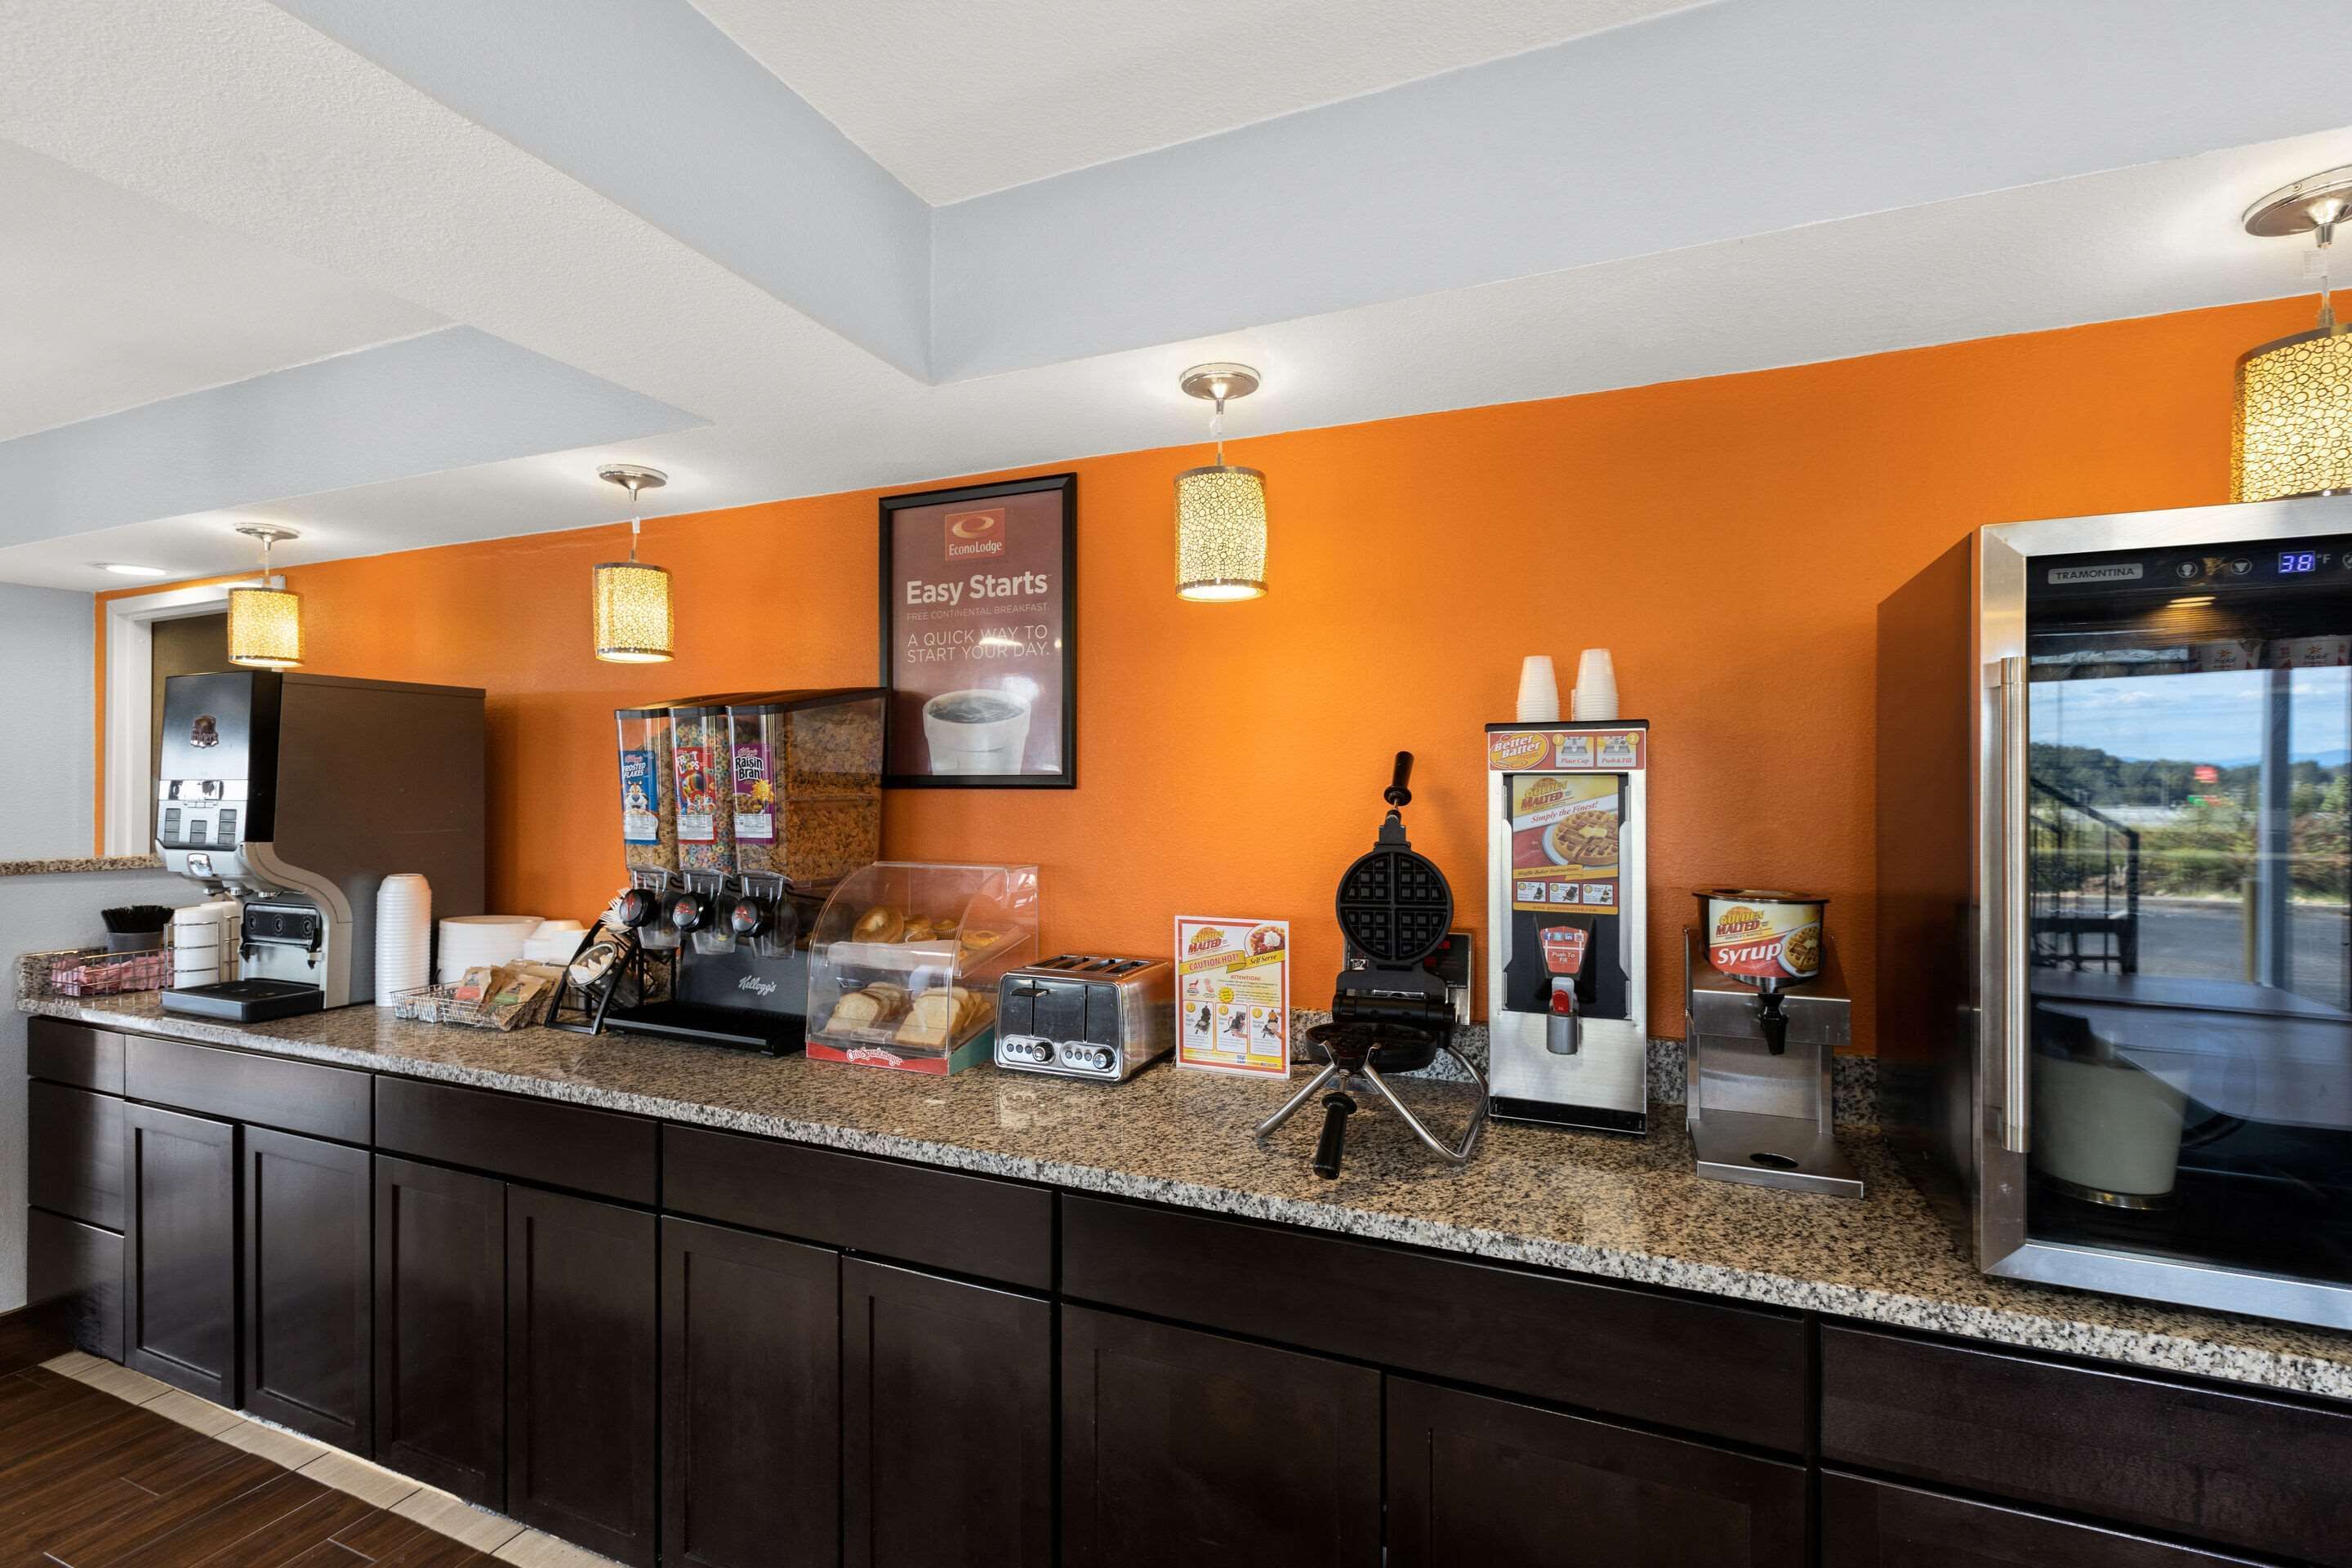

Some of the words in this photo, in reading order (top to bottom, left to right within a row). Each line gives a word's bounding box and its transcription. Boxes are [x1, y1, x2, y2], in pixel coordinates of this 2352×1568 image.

[949, 540, 1003, 556] EconoLodge
[2281, 555, 2313, 572] 38
[2055, 568, 2135, 580] TRAMONTINA
[906, 580, 964, 606] Easy
[969, 571, 1049, 599] Starts
[906, 612, 929, 621] FREE
[930, 608, 991, 620] CONTINENTAL
[907, 634, 919, 648] A
[924, 629, 975, 646] QUICK
[980, 626, 1018, 642] WAY
[1024, 625, 1048, 639] TO
[907, 647, 956, 663] START
[961, 644, 1007, 660] YOUR
[1013, 641, 1050, 657] DAY.
[1494, 735, 1534, 752] Better
[1502, 742, 1541, 759] Batter
[623, 763, 646, 772] FROSTED
[735, 756, 764, 770] Raisin
[624, 770, 644, 778] FLAKES
[738, 768, 760, 780] Bran
[1521, 791, 1563, 809] MALTED
[1531, 811, 1558, 823] Simply
[1559, 808, 1570, 817] the
[1573, 800, 1598, 813] Finest!
[1716, 920, 1761, 936] MALTED
[1188, 938, 1223, 954] MALTED
[1717, 942, 1782, 966] Syrup
[1189, 956, 1221, 971] CAUTION
[1222, 953, 1239, 964] HOT!
[1250, 956, 1261, 964] Self
[1261, 954, 1278, 964] Serve
[738, 975, 777, 996] Kellogg's
